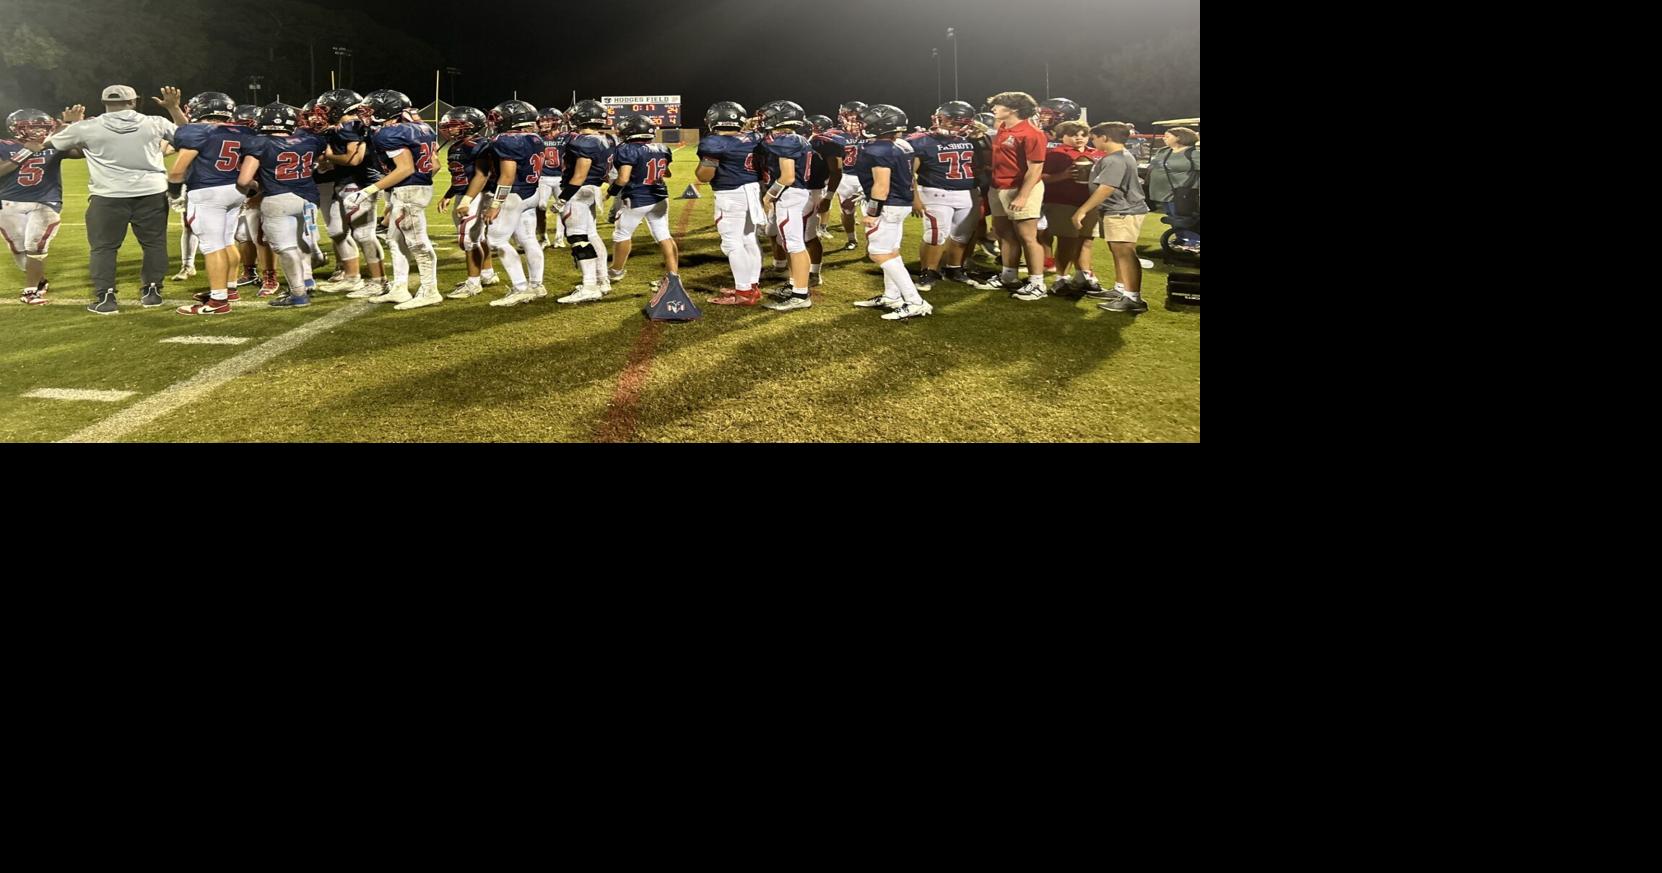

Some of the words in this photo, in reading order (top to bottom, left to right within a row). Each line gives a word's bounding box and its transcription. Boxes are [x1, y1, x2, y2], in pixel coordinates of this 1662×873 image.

[17, 157, 46, 187] 5
[275, 151, 314, 181] 21
[643, 158, 670, 185] 12
[938, 151, 975, 180] 72
